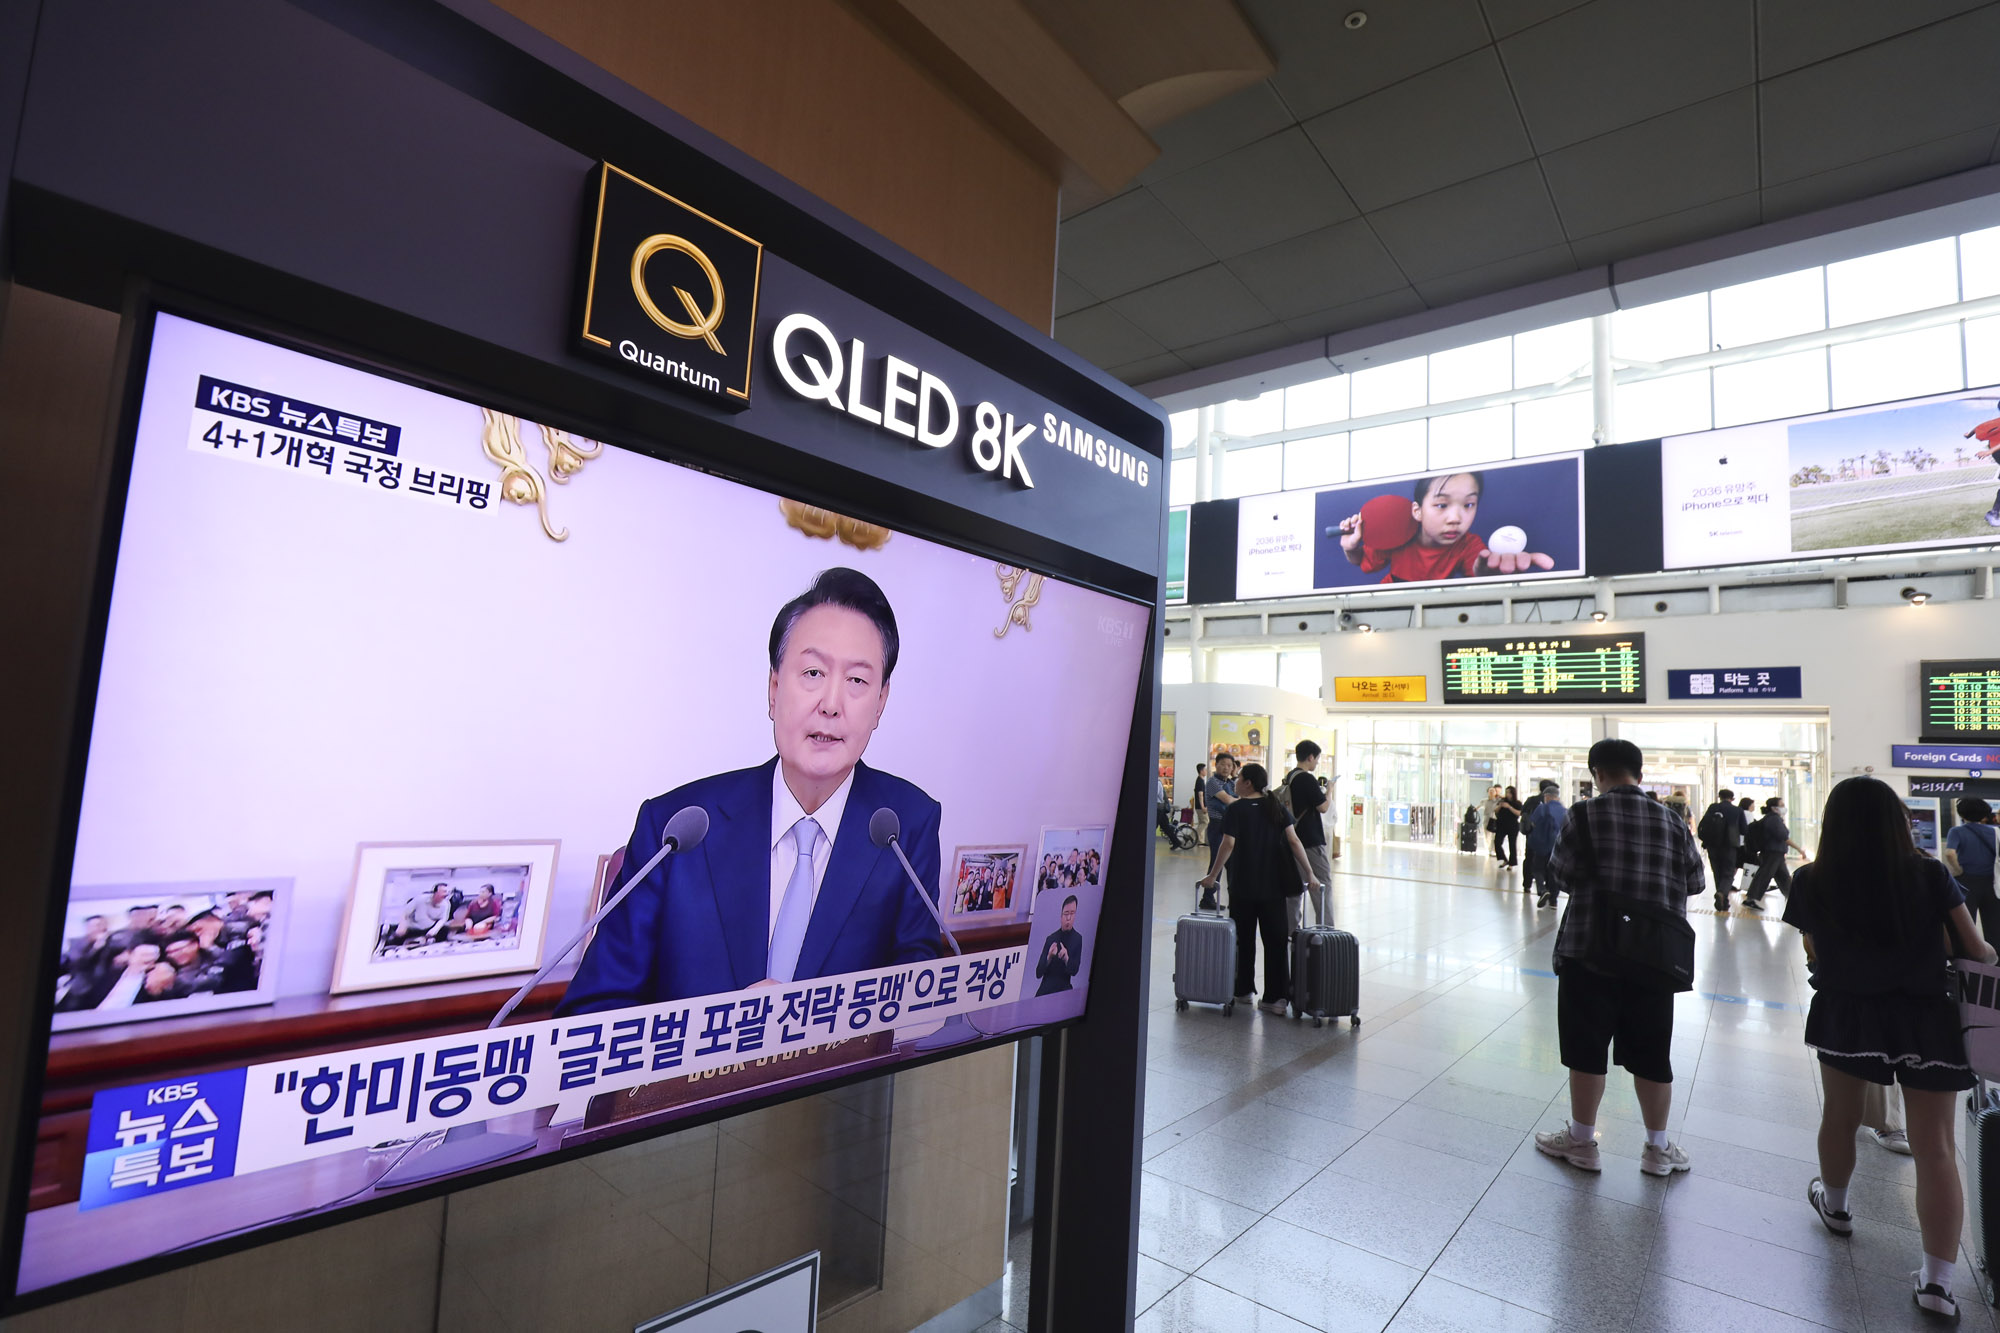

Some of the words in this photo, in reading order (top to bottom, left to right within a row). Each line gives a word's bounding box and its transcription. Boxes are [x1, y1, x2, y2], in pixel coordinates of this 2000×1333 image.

[618, 339, 720, 394] Quantum
[209, 385, 271, 418] KBS
[279, 401, 389, 449] 뉴스특보
[772, 312, 959, 448] QLED
[971, 401, 1037, 489] 8K
[202, 420, 336, 475] 4+1개혁
[343, 450, 402, 490] 국정
[409, 466, 491, 510] 브리핑
[1043, 411, 1149, 487] SAMSUNG
[1681, 495, 1744, 511] iPhone으로
[1692, 486, 1722, 498] 2036
[1352, 681, 1378, 692] 나오는
[1724, 672, 1750, 686] 타는
[1757, 672, 1770, 686] 곳
[1904, 751, 1946, 763] Foreign
[1949, 752, 1982, 763] Cards
[1971, 770, 1981, 778] 10
[274, 1034, 535, 1145] "한미동맹
[550, 1008, 690, 1091] '글로벌
[694, 995, 774, 1058] 포괄
[777, 983, 845, 1044] 전략
[847, 964, 961, 1030] 동맹'으로
[964, 951, 1021, 1002] 격상"
[147, 1081, 199, 1106] KBS
[114, 1097, 219, 1148] 뉴스
[109, 1136, 216, 1190] 특보
